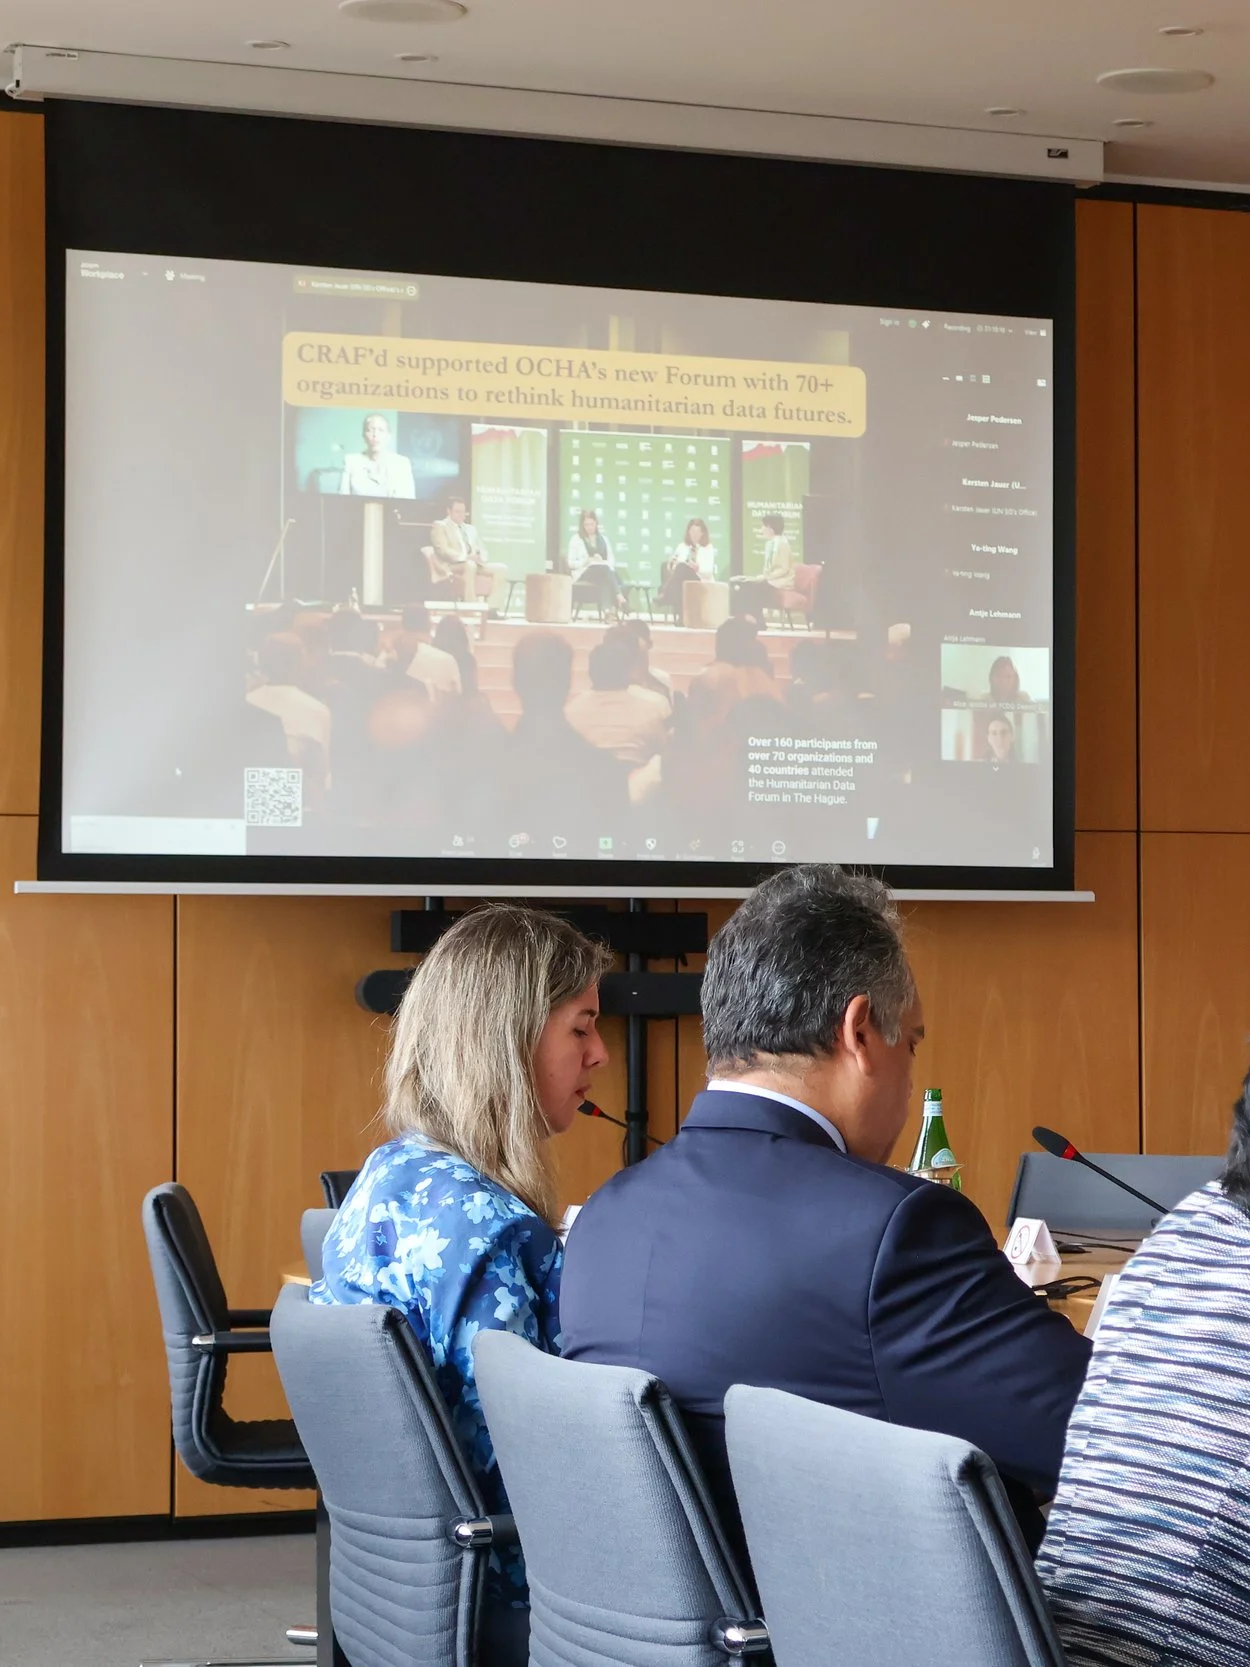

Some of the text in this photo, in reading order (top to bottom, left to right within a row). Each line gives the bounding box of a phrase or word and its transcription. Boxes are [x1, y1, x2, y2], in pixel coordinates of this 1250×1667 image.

[297, 343, 834, 393] CRAF'd supported OCHA's new Forum with 70+
[297, 377, 853, 425] organizations to rethink humanitarian data futures.
[966, 413, 1022, 425] Jesper Pedersen
[962, 477, 989, 487] Kersten
[990, 480, 1010, 489] Jauer
[997, 545, 1019, 556] Wang
[969, 608, 1022, 619] Antje Lehmann
[748, 736, 878, 751] Over 160 participants from
[748, 751, 874, 764] over 70 organizations and
[748, 764, 854, 777] 40 countries attended
[748, 777, 856, 791] the Humanitarian Data
[748, 791, 848, 806] Forum in The Hague.
